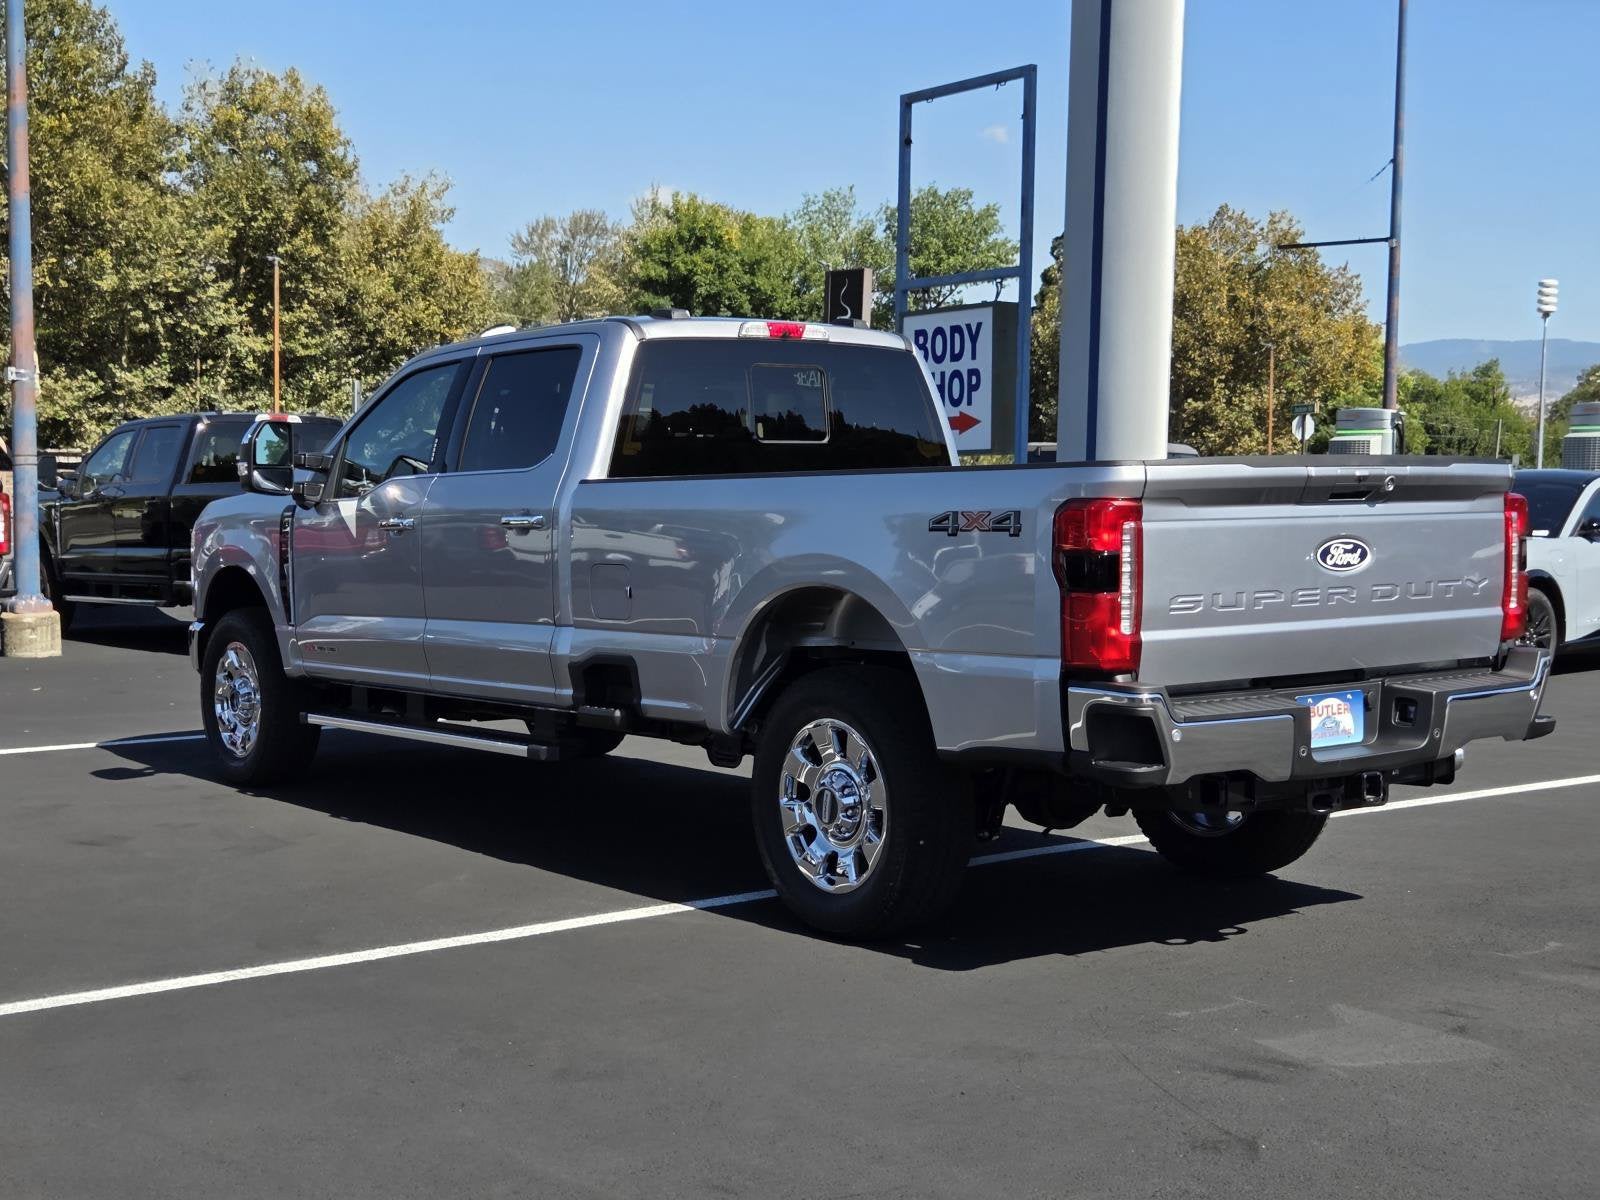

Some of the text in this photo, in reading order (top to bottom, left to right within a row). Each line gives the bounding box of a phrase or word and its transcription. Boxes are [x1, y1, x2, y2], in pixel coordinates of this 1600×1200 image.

[914, 322, 982, 365] BODY
[931, 368, 982, 407] HOP
[928, 510, 1022, 537] 4X4
[1326, 543, 1361, 566] Ford
[1169, 577, 1489, 615] SUPER DUTY
[1310, 703, 1350, 718] BUTLER
